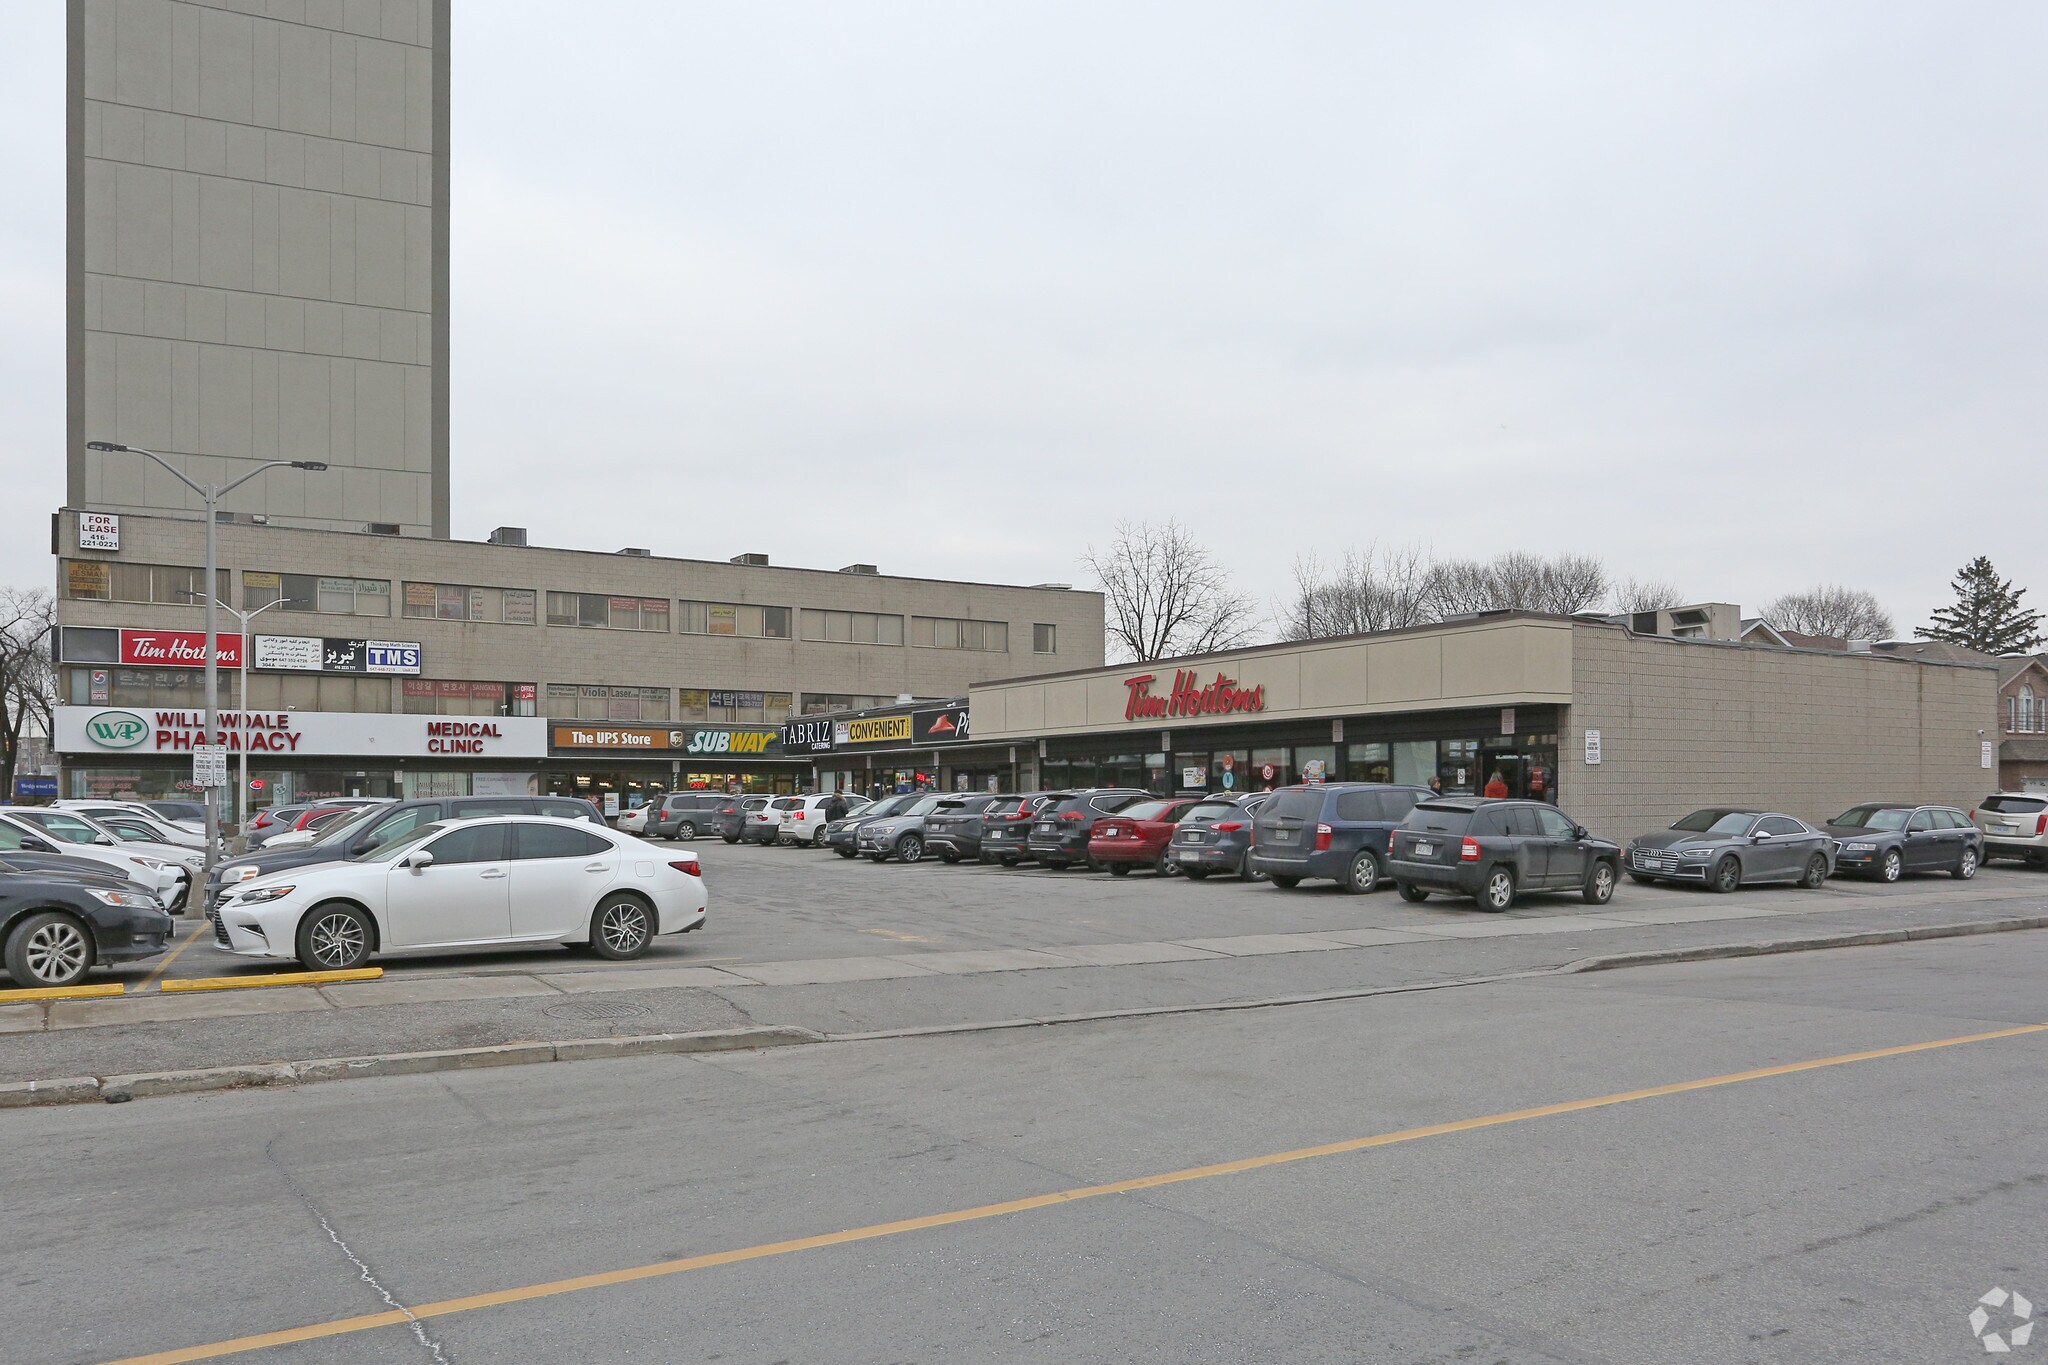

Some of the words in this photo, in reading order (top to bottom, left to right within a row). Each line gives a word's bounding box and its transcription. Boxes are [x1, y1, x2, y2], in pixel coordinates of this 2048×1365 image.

[88, 516, 110, 524] FOR
[82, 524, 117, 534] LEASE
[81, 540, 118, 548] 221-0221
[132, 638, 165, 658] Tim
[168, 638, 239, 662] Hortns.
[324, 648, 355, 665] تبریز
[370, 649, 417, 666] TMS
[581, 687, 607, 697] Viola
[710, 692, 735, 706] 석탑
[1124, 675, 1166, 721] Tim
[1168, 668, 1264, 717] Hortons
[155, 712, 289, 730] WILLWDALE
[837, 723, 848, 732] ATM
[955, 711, 970, 737] Pi
[427, 722, 503, 737] MEDICAL
[780, 721, 830, 745] TABRIZ
[849, 719, 906, 740] CONVENIENT
[571, 731, 594, 743] The
[596, 731, 619, 744] UPS
[621, 732, 651, 745] Store
[670, 735, 683, 745] ups
[687, 731, 777, 752] SUBWAY
[427, 739, 484, 753] CLINIC
[811, 742, 831, 750] CATERING
[689, 781, 707, 789] OPEN
